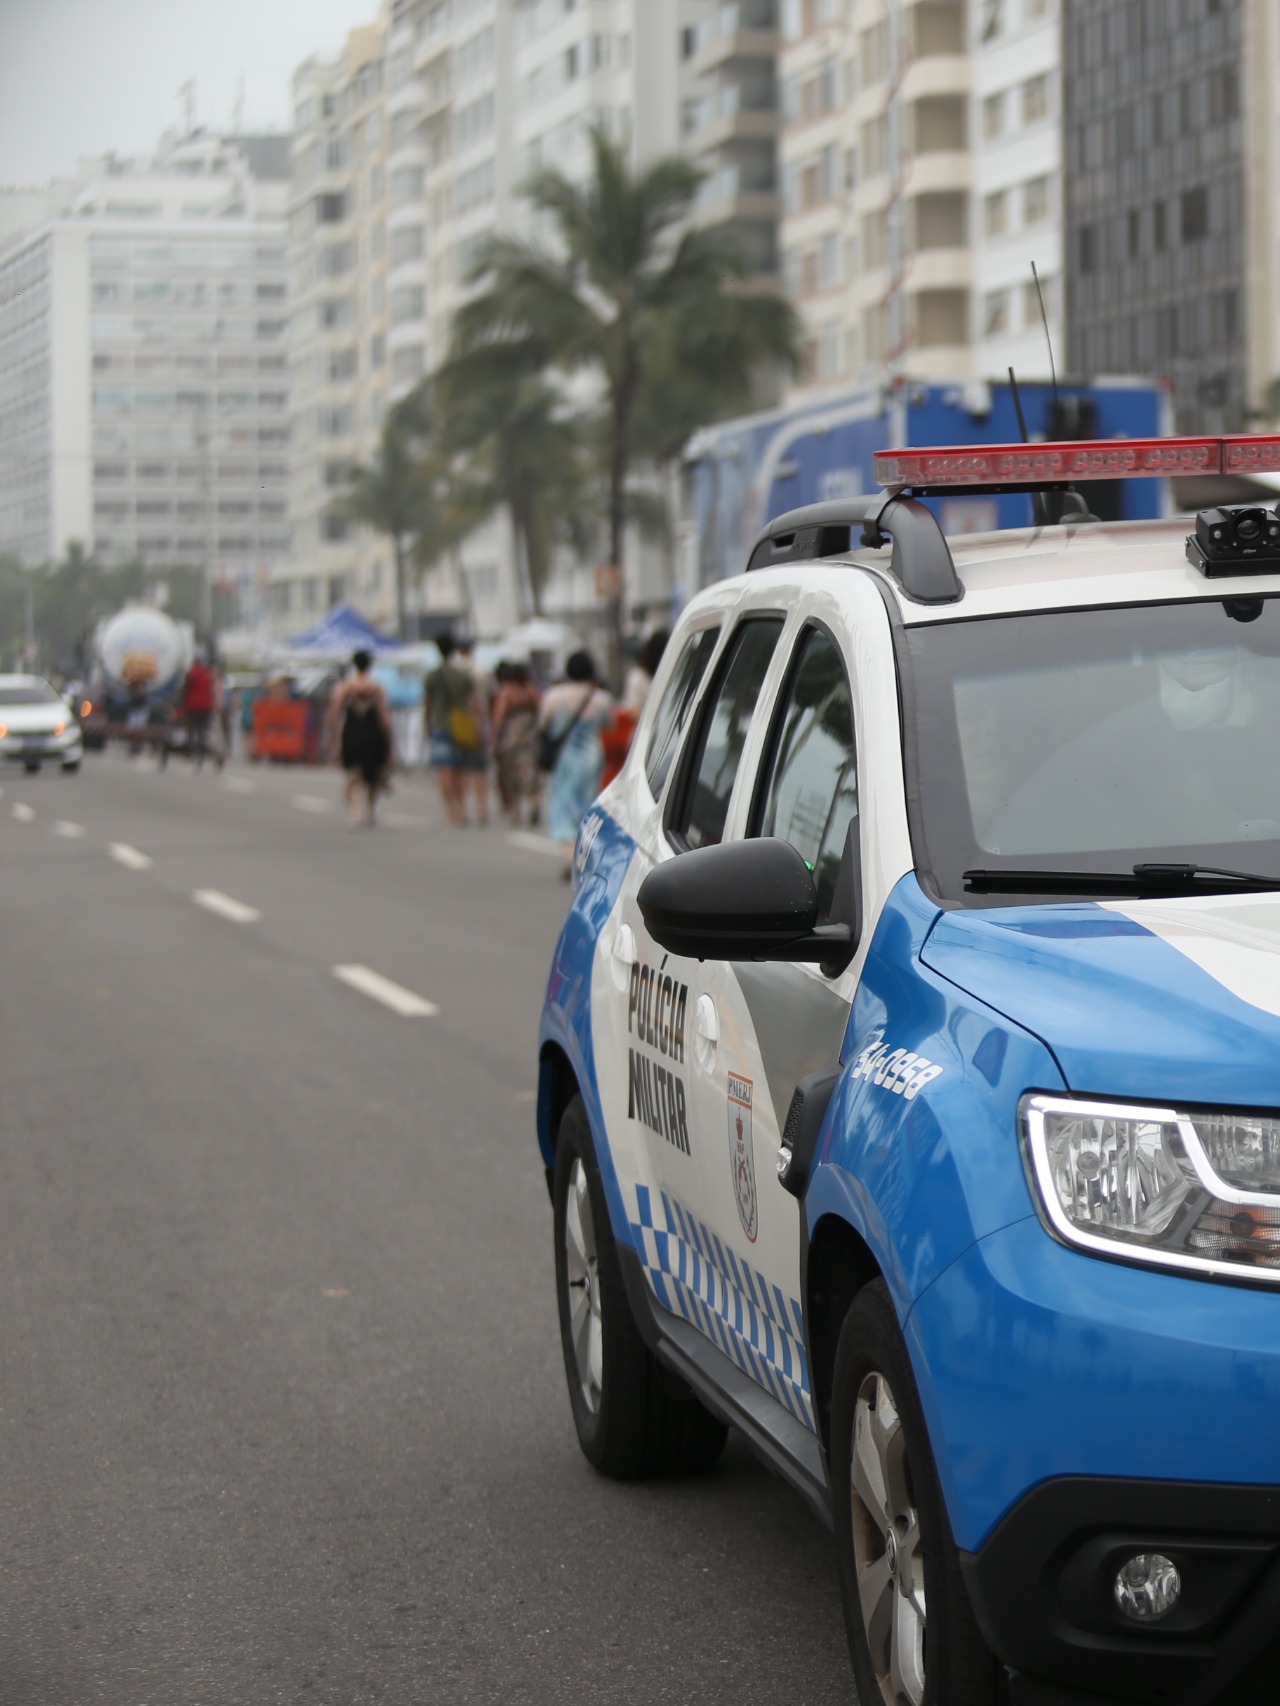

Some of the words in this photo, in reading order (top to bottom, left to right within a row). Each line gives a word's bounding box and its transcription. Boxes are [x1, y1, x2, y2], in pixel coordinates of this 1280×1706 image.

[628, 953, 689, 1065] POLÍCIA
[627, 1046, 692, 1157] MILITAR
[728, 1077, 753, 1104] PMERJ
